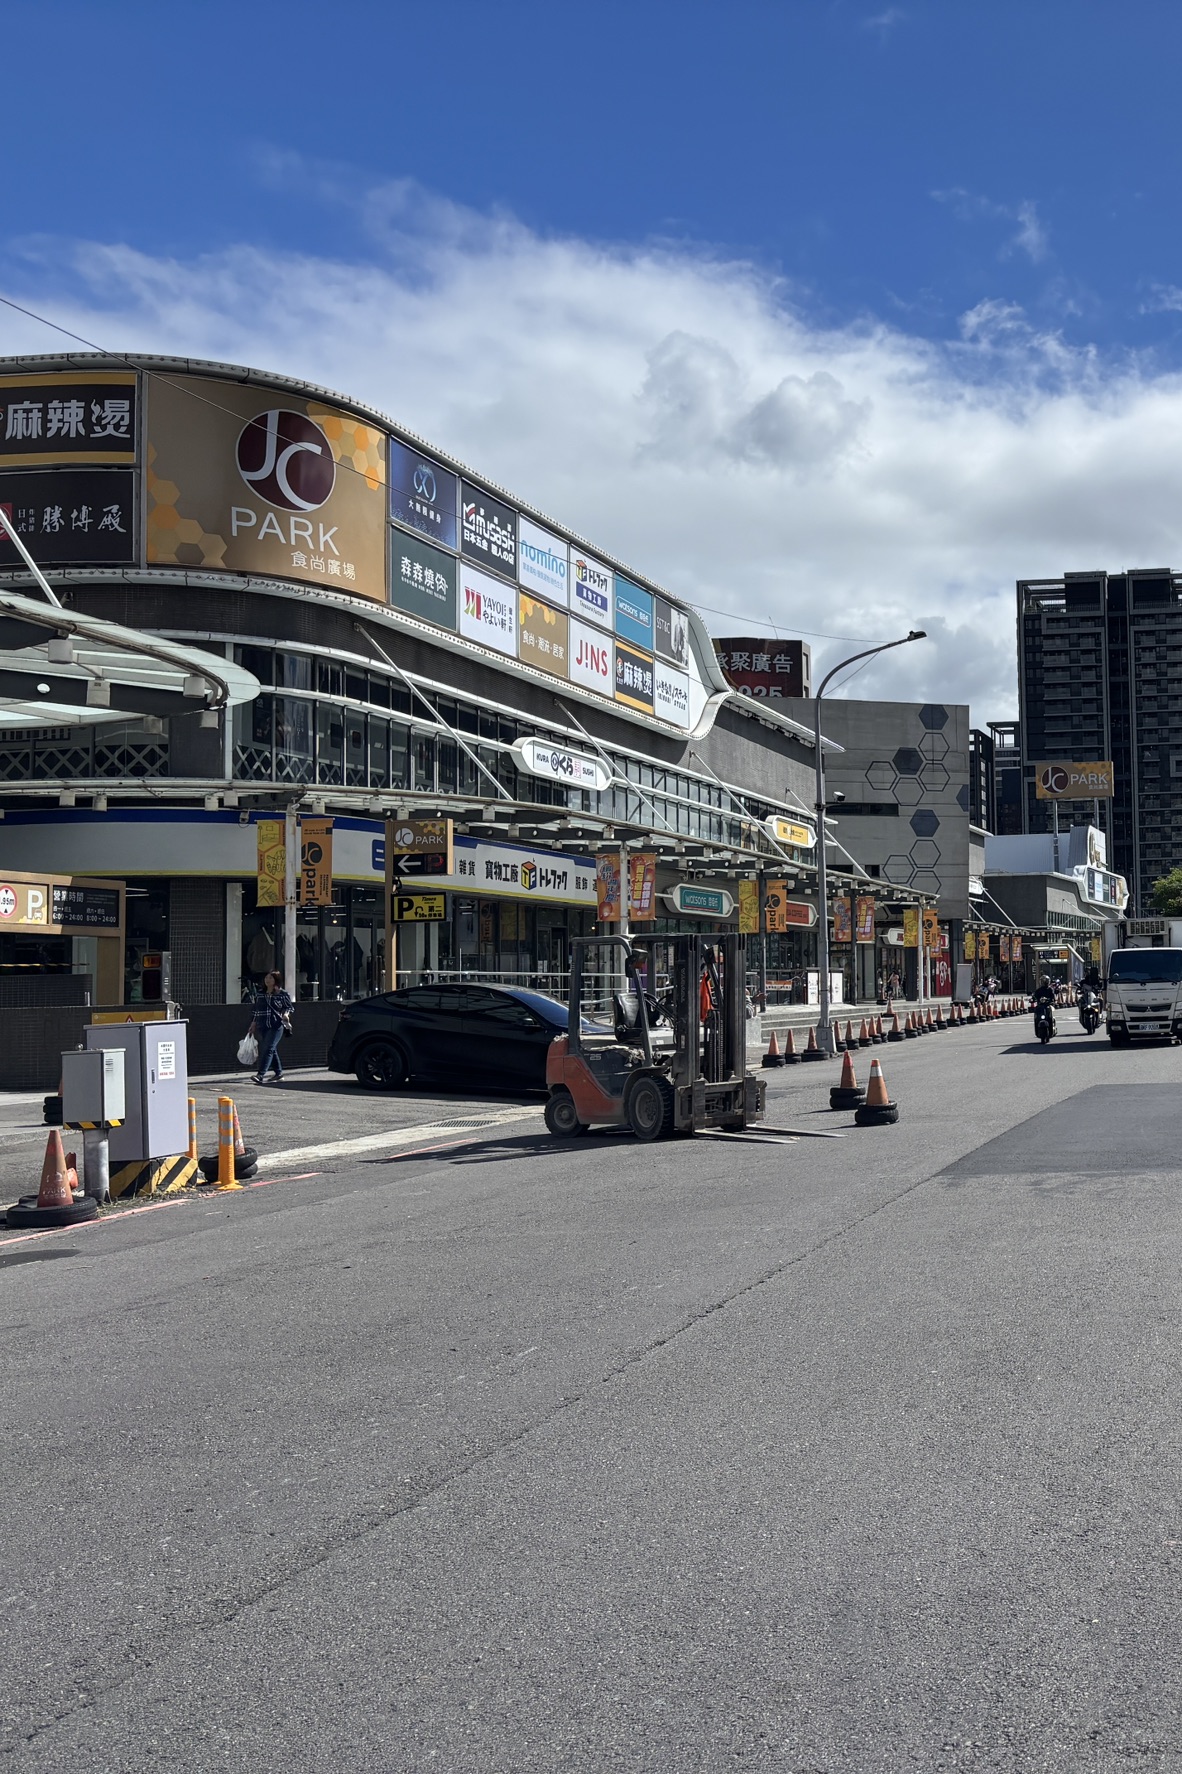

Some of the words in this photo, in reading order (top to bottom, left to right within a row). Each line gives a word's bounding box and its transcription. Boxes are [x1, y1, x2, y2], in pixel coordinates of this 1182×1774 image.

[18, 509, 26, 532] 日式
[40, 504, 126, 533] 勝博殿
[231, 506, 340, 555] PARK
[464, 528, 489, 551] 日本五金
[291, 551, 356, 580] 食尚廣場
[520, 539, 566, 578] nomino
[617, 600, 638, 617] watsons
[560, 756, 574, 776] くら
[1070, 773, 1108, 785] PARK
[415, 836, 443, 845] PARK
[459, 859, 476, 876] 雜貨
[27, 889, 43, 919] P
[53, 889, 84, 903] 營業時間
[685, 894, 707, 905] watsons
[397, 898, 414, 920] P
